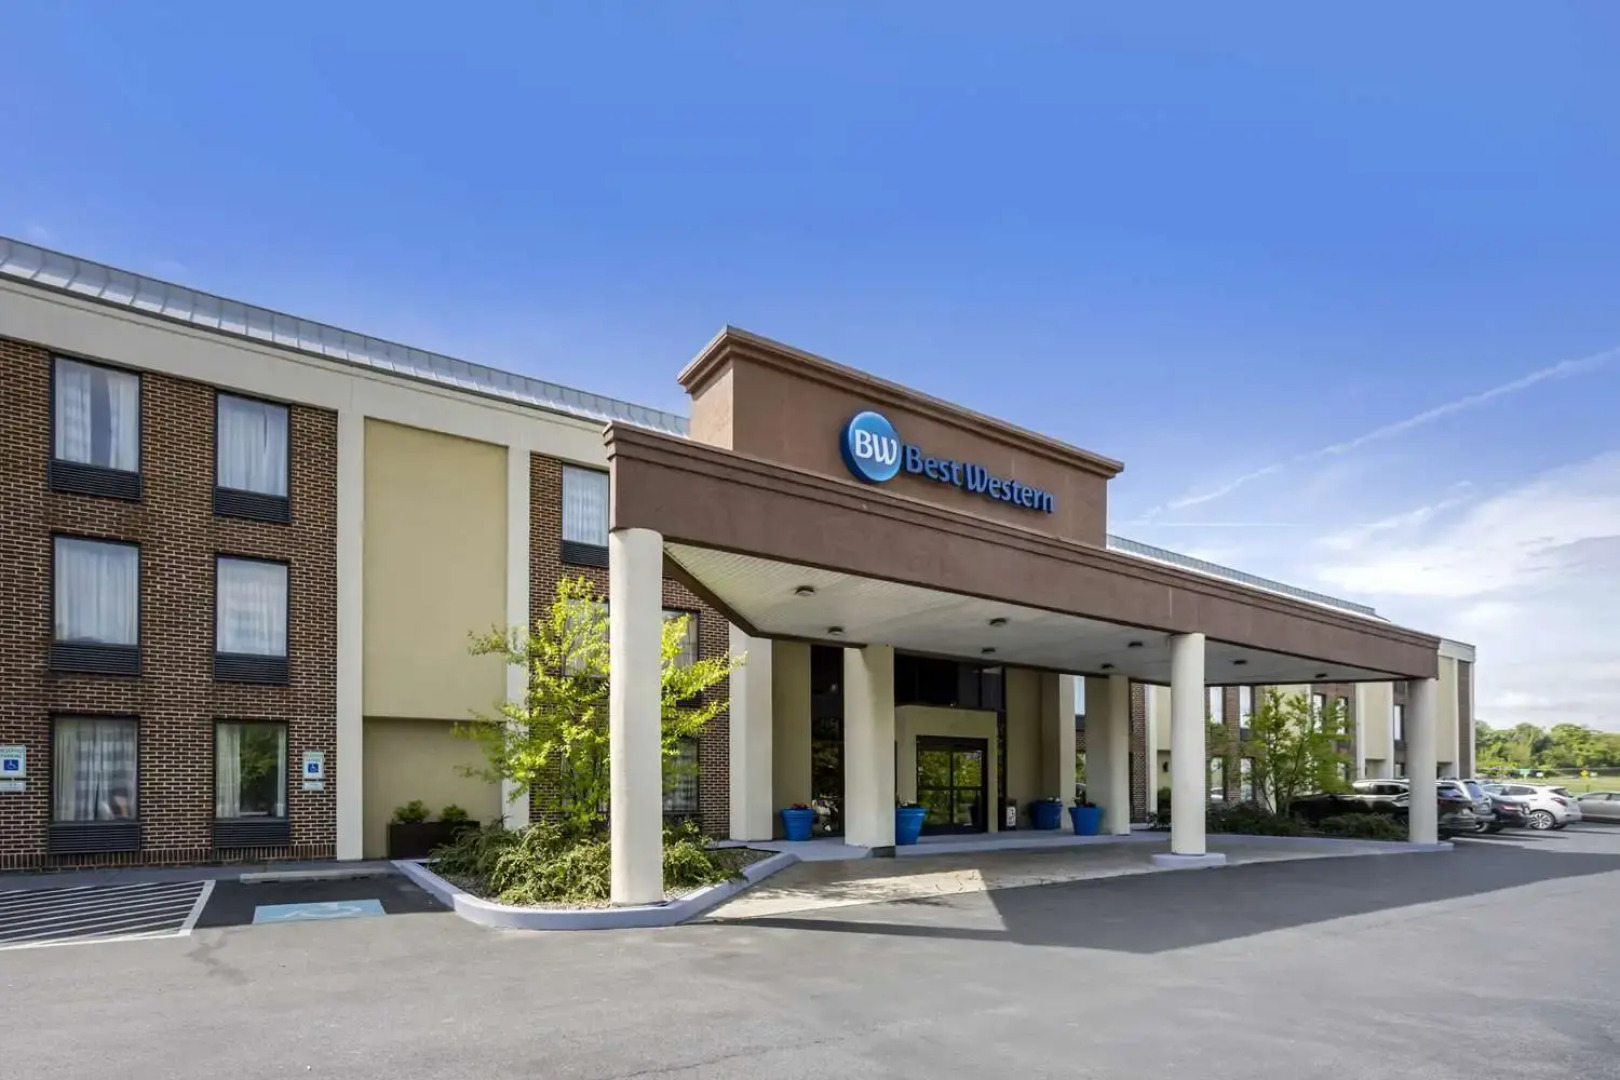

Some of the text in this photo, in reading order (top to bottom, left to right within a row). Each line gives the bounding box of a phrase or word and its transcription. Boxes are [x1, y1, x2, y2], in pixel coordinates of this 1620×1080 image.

[854, 429, 898, 465] BW
[904, 445, 1055, 513] Best Western
